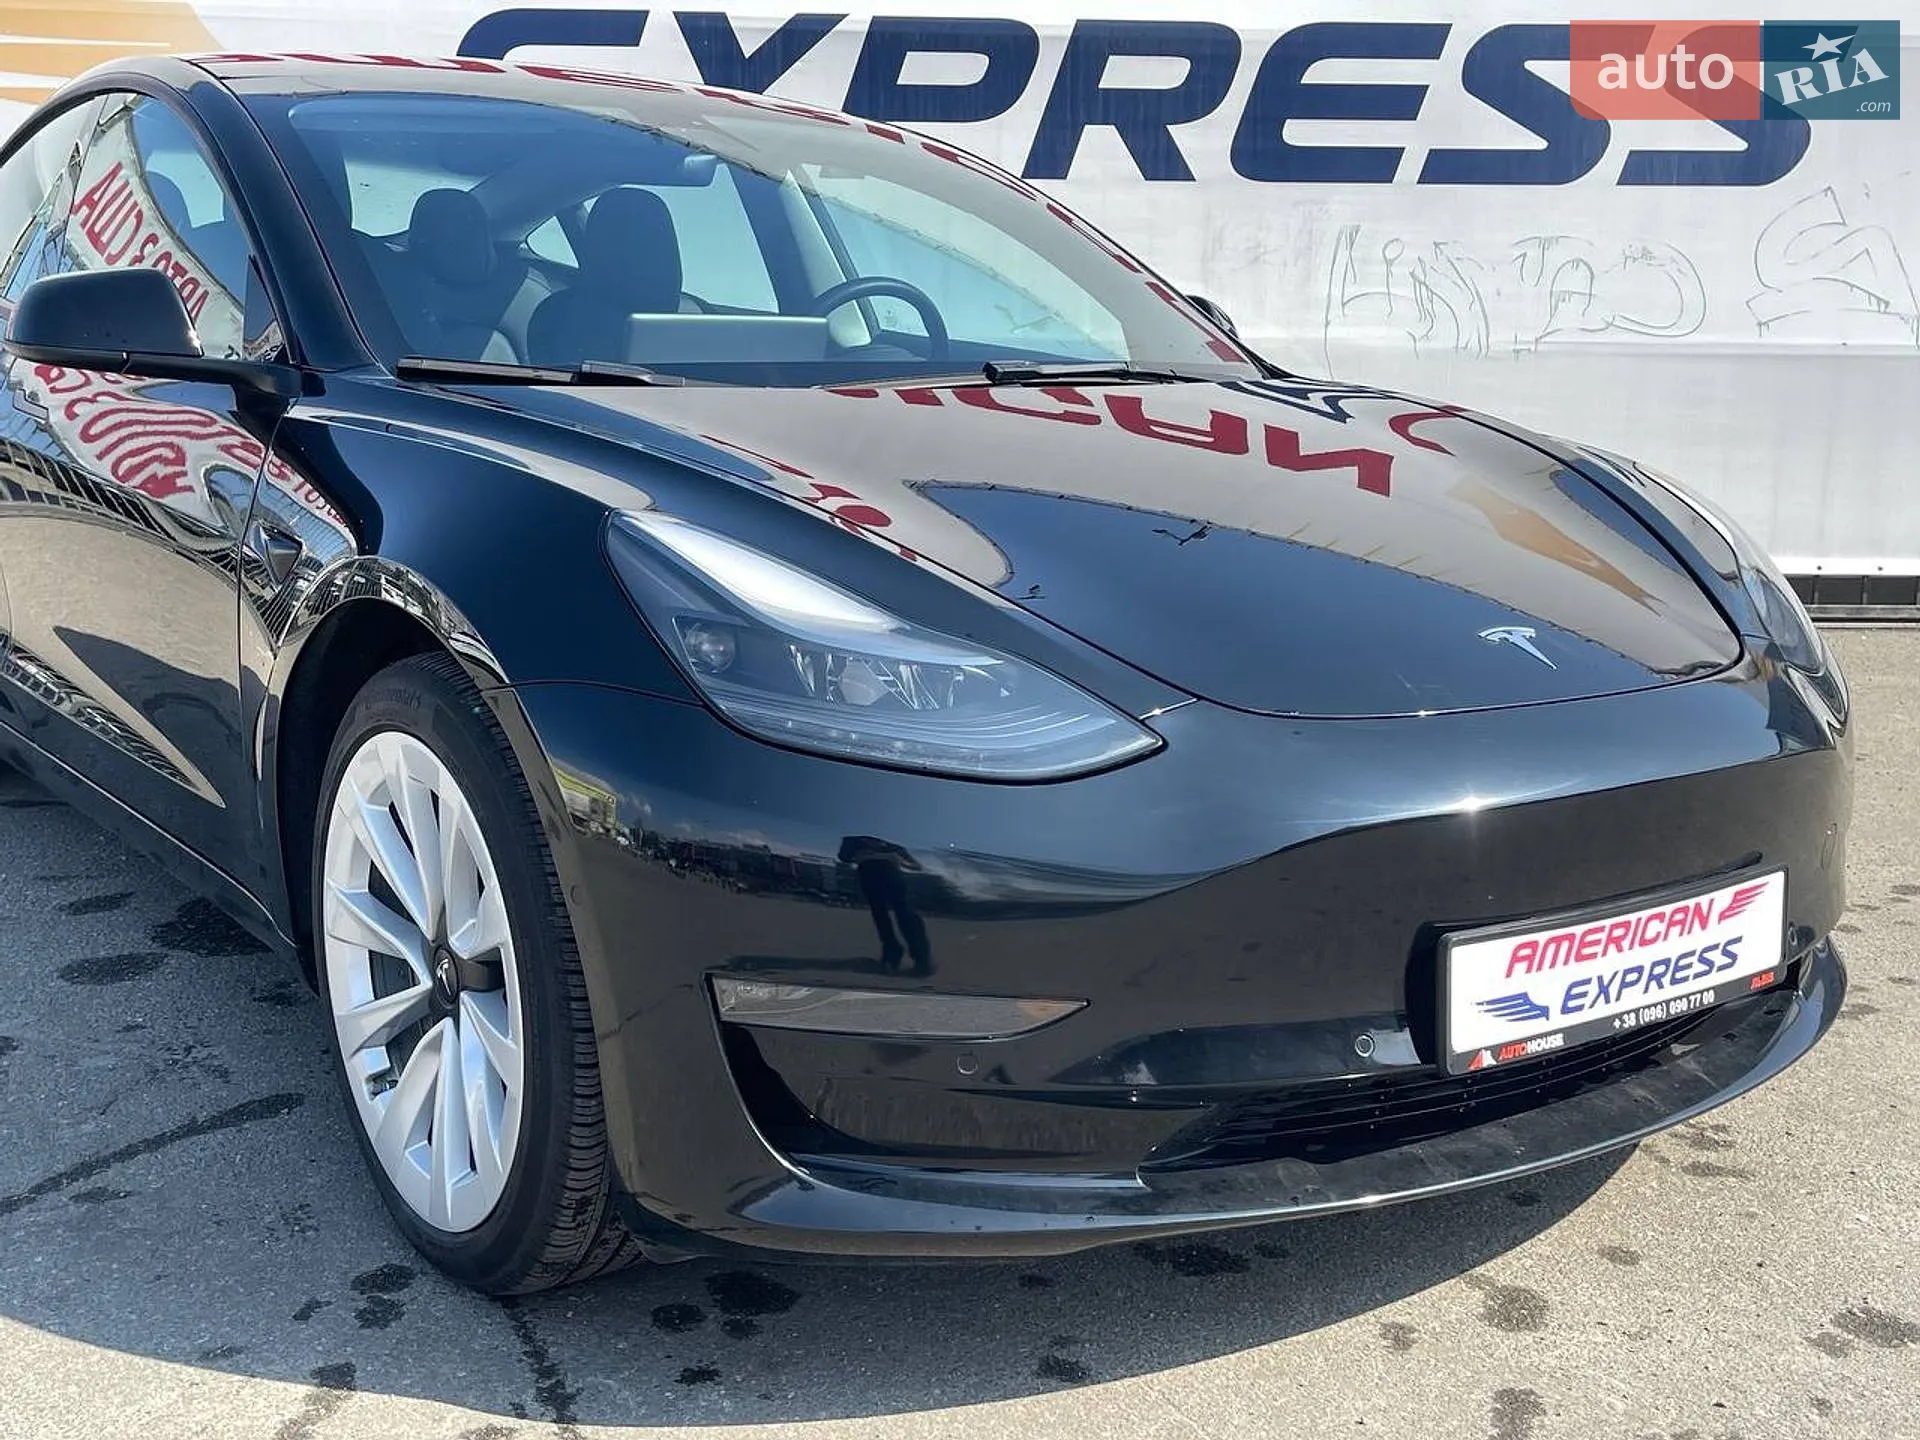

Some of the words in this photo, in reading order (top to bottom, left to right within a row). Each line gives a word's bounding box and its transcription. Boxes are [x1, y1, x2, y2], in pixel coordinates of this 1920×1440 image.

[1505, 898, 1715, 979] AMERICAN
[1559, 936, 1743, 1015] EXPRESS
[1688, 993, 1701, 1009] 77
